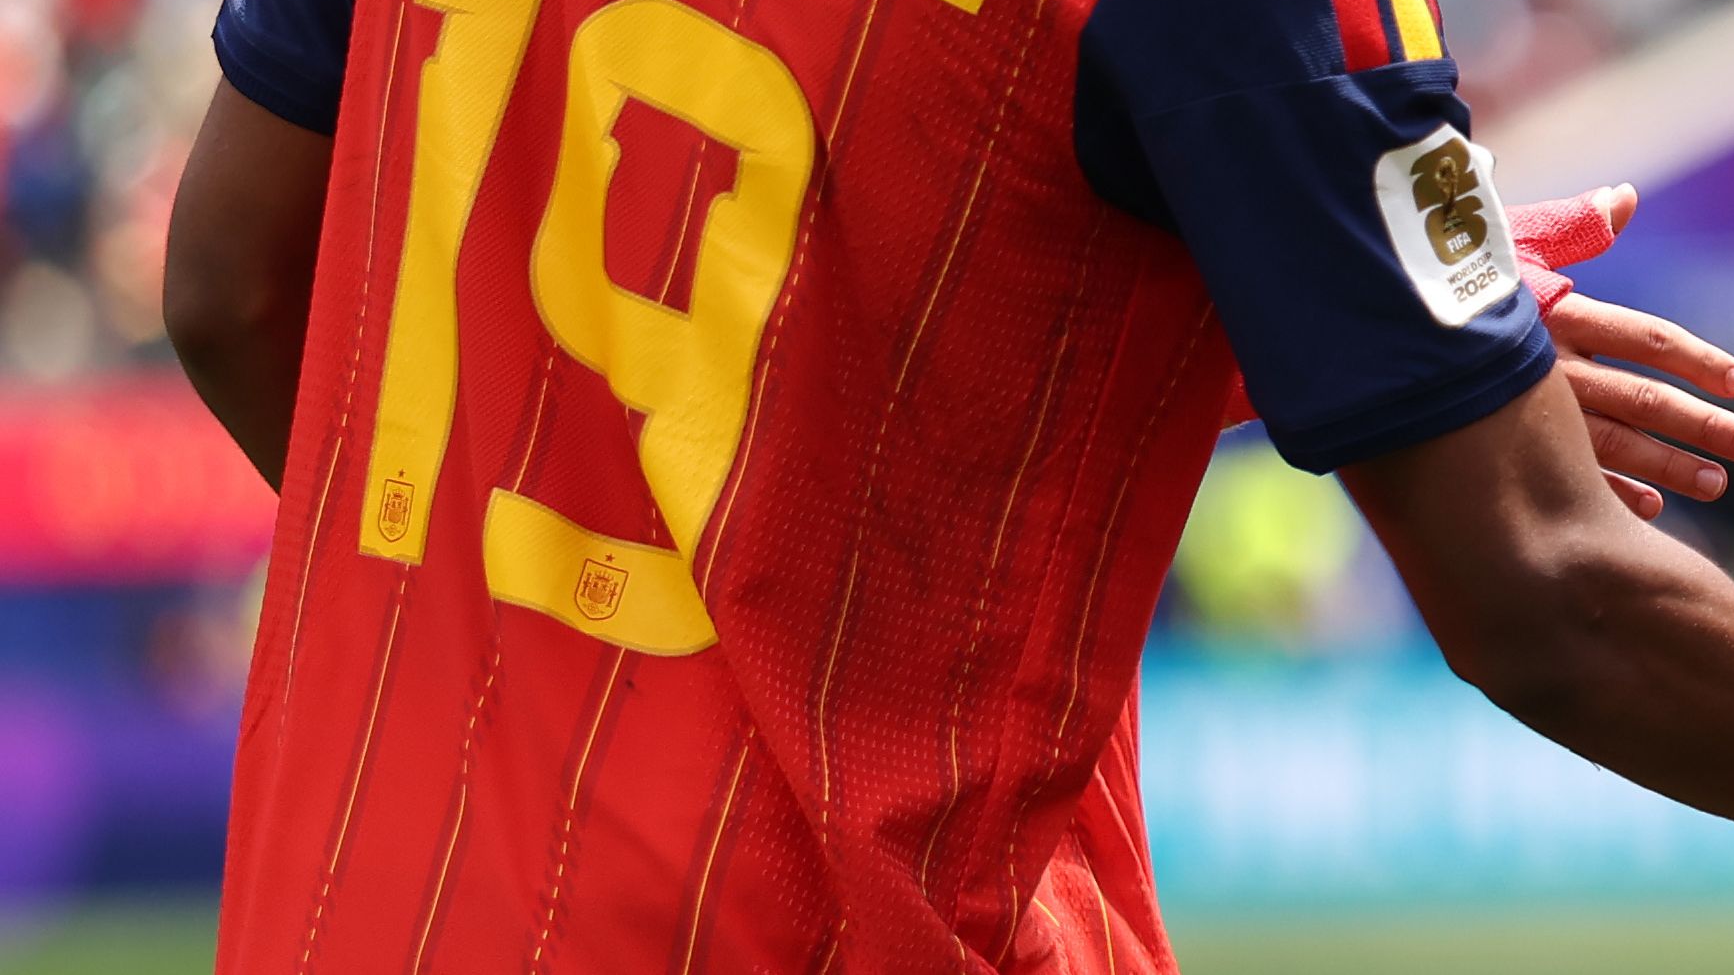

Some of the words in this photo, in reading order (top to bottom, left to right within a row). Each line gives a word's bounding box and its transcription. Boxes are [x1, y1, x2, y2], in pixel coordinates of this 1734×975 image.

[1446, 231, 1473, 254] FIFA
[1447, 261, 1478, 286] WORLD
[1453, 265, 1499, 304] 2026
